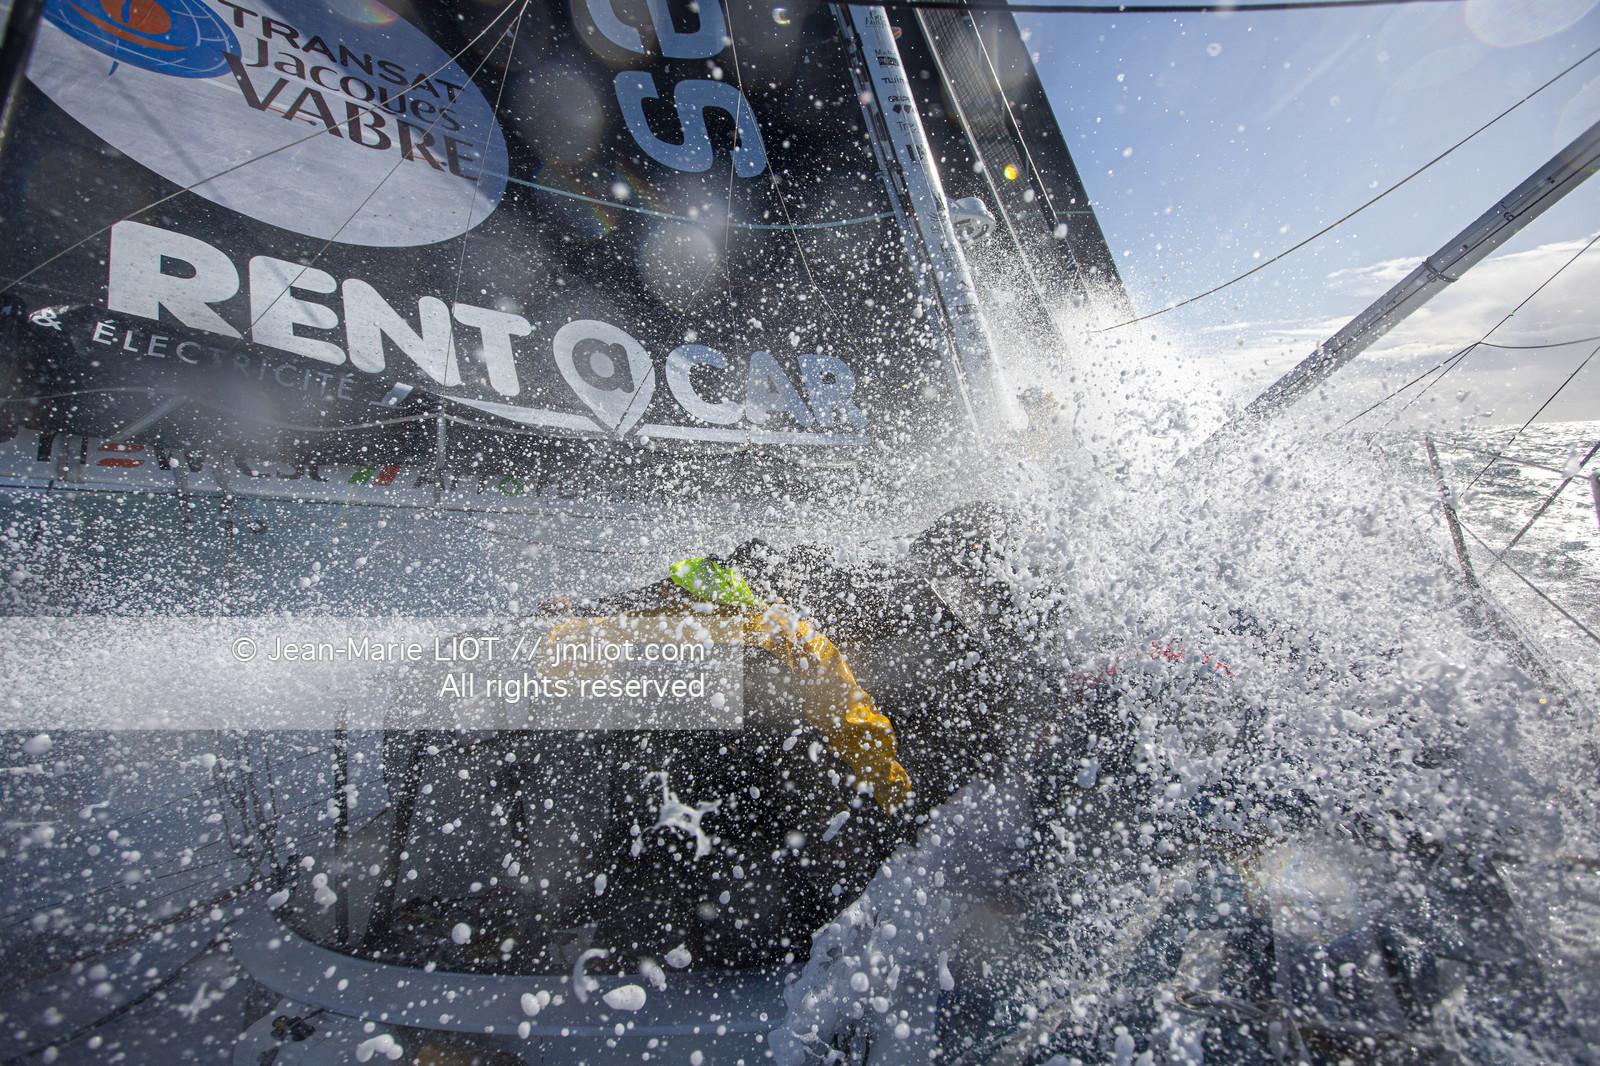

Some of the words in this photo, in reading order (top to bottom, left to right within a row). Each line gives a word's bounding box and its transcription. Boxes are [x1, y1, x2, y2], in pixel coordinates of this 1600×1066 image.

[218, 0, 465, 104] TRANSAT
[220, 49, 480, 183] VABRE
[107, 220, 532, 397] RENT
[665, 343, 869, 428] CAR
